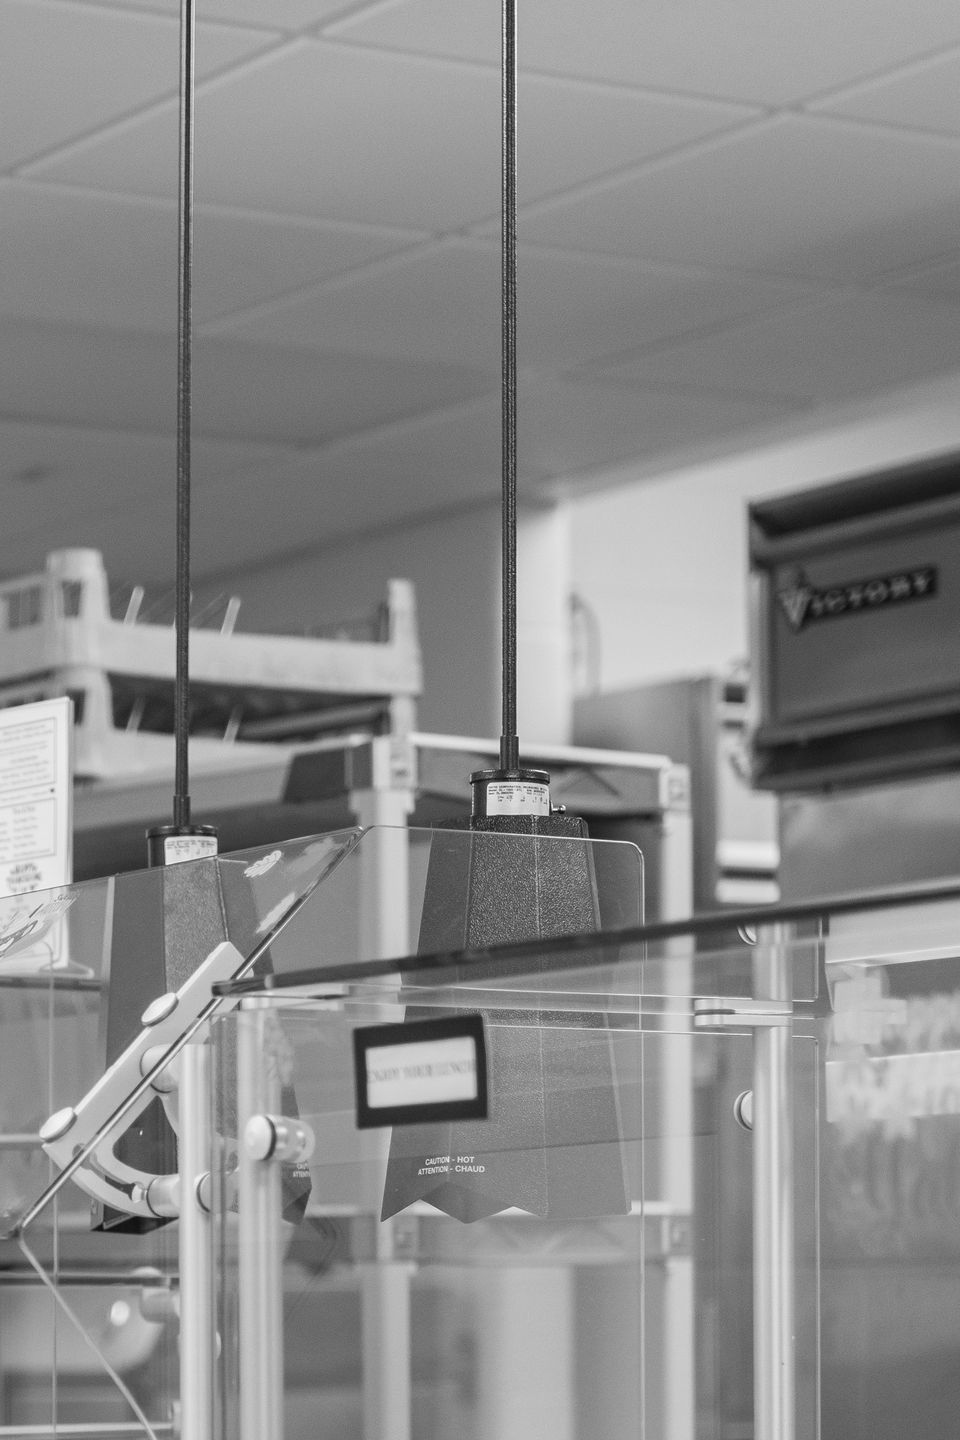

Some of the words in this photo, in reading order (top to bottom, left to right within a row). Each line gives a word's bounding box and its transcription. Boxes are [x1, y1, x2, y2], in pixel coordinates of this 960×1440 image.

[425, 1155, 450, 1166] CAUTION
[456, 1156, 475, 1164] HOT
[417, 1165, 449, 1176] ATTENTION
[454, 1165, 486, 1173] CHAUD
